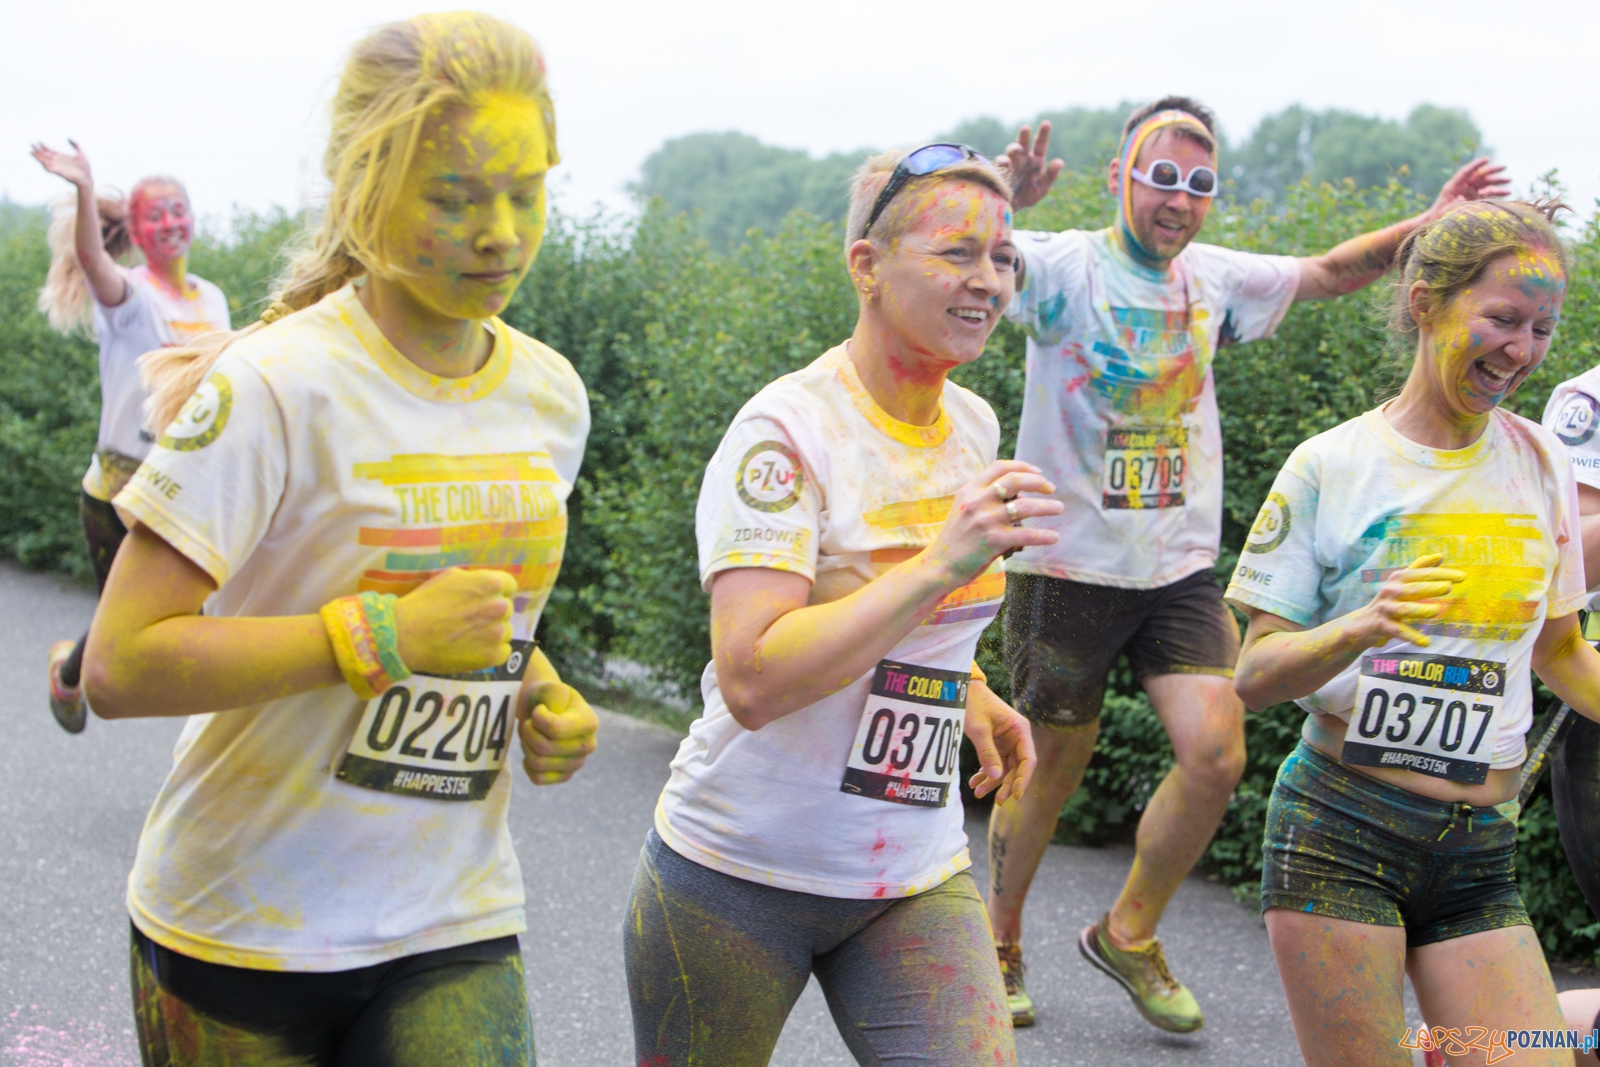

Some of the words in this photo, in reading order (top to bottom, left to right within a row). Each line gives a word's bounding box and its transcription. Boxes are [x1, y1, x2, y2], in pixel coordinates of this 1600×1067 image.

[1560, 406, 1588, 429] PZU
[748, 461, 789, 491] PZU
[1110, 456, 1184, 490] 03709
[393, 486, 442, 524] THE
[446, 484, 517, 522] COLOR
[518, 484, 560, 520] RUN
[734, 528, 803, 544] ZDROWIE
[1238, 565, 1273, 586] OWIE
[884, 671, 909, 694] THE
[907, 675, 944, 700] COLOR
[1372, 658, 1399, 675] THE
[1399, 660, 1445, 683] COLOR
[1443, 665, 1470, 686] RUN
[366, 685, 511, 763] 02204
[1358, 688, 1494, 755] 03707
[862, 708, 961, 776] 03706
[1380, 751, 1450, 775] #HAPPIEST5K
[393, 770, 472, 795] #HAPPIEST5K
